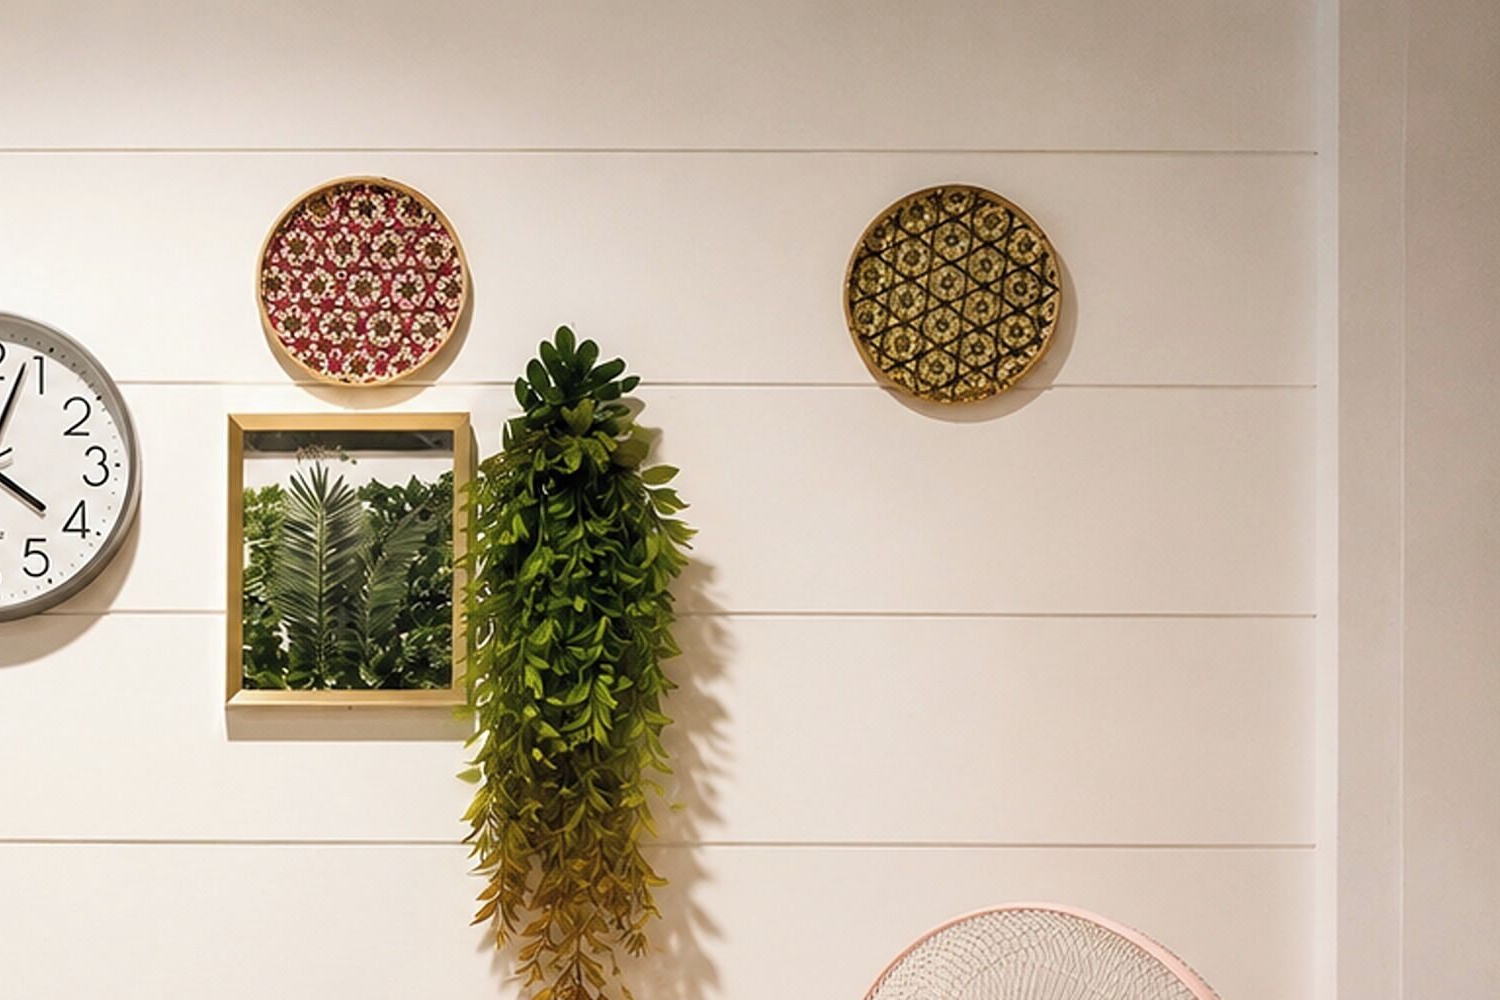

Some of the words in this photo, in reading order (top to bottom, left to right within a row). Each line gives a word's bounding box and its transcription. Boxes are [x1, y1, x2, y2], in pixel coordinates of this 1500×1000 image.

[33, 355, 45, 395] 1
[63, 396, 92, 437] 2
[82, 445, 110, 487] 3
[61, 499, 91, 540] 4
[22, 538, 50, 578] 5
